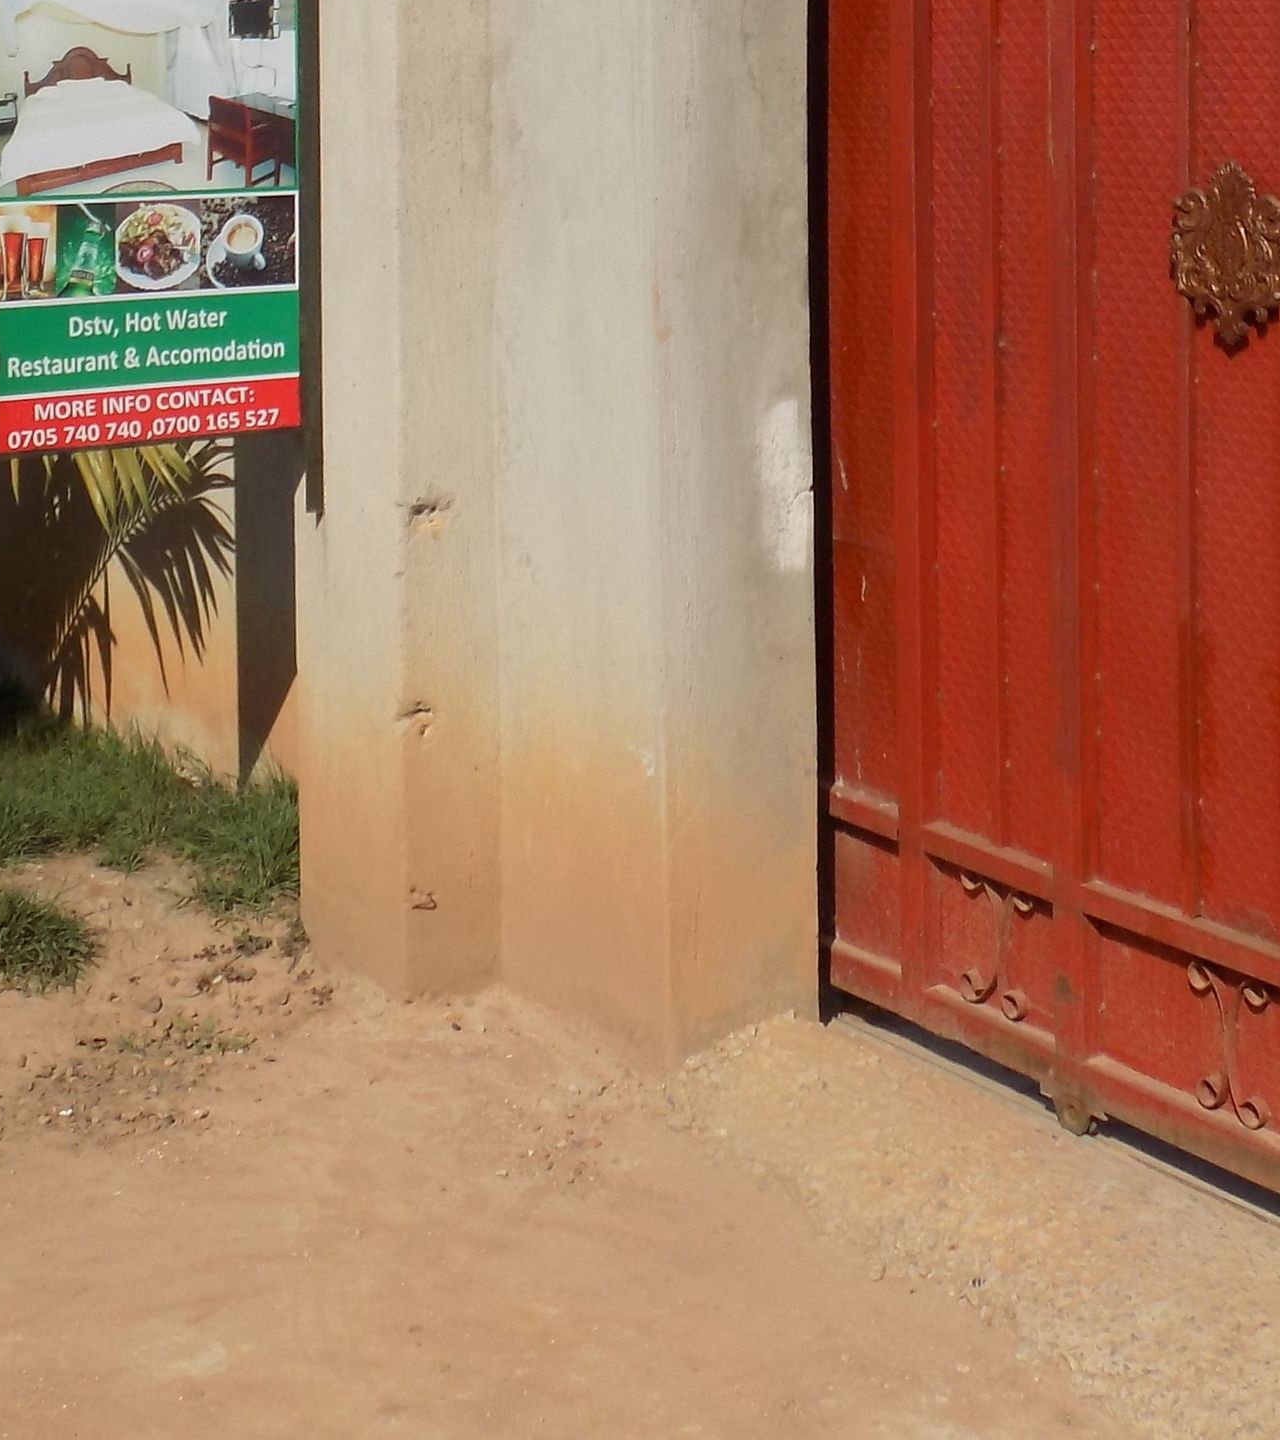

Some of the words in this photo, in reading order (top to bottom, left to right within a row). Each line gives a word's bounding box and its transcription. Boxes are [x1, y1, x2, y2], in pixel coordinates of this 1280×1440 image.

[69, 315, 120, 338] Dstv,
[125, 312, 161, 333] Hot
[166, 309, 227, 330] Water
[8, 350, 118, 378] Restaurant
[123, 347, 140, 368] &
[145, 339, 285, 366] Accomodation
[34, 399, 96, 421] MORE
[102, 395, 151, 415] INFO
[156, 386, 255, 411] CONTACT:
[7, 428, 58, 449] 0705
[64, 424, 100, 444] 740
[106, 420, 142, 440] 740
[206, 411, 240, 431] 165
[245, 408, 280, 427] 527
